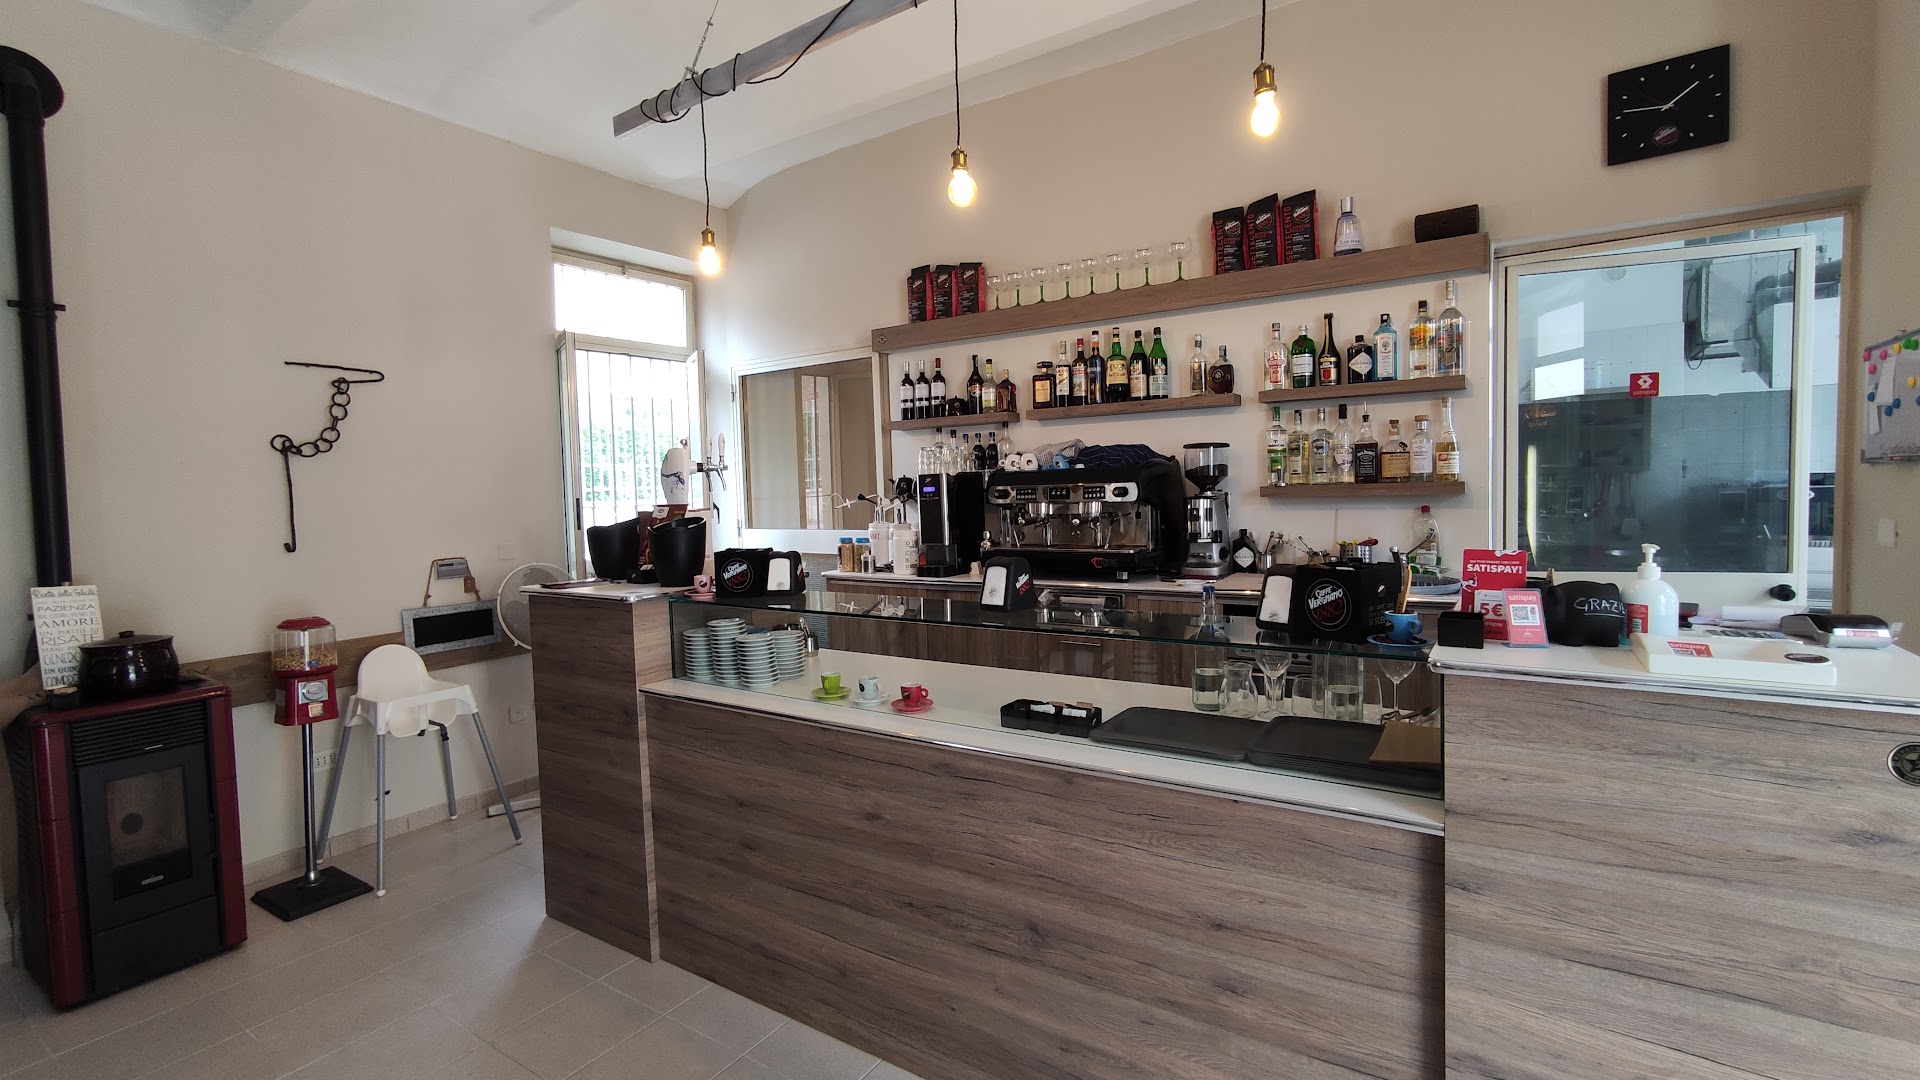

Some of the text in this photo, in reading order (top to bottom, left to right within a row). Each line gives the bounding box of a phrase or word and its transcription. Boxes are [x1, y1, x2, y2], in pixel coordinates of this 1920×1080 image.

[1466, 563, 1523, 574] SATISPAY!
[1308, 589, 1344, 610] VERGNANO
[1507, 594, 1537, 602] satispay
[37, 603, 96, 612] PAZIENZA
[1316, 599, 1343, 623] 1882
[1480, 602, 1504, 617] 5€
[39, 616, 100, 629] AMORE
[41, 633, 99, 647] RISATE
[1669, 642, 1706, 650] satispay
[43, 651, 82, 666] GENERO
